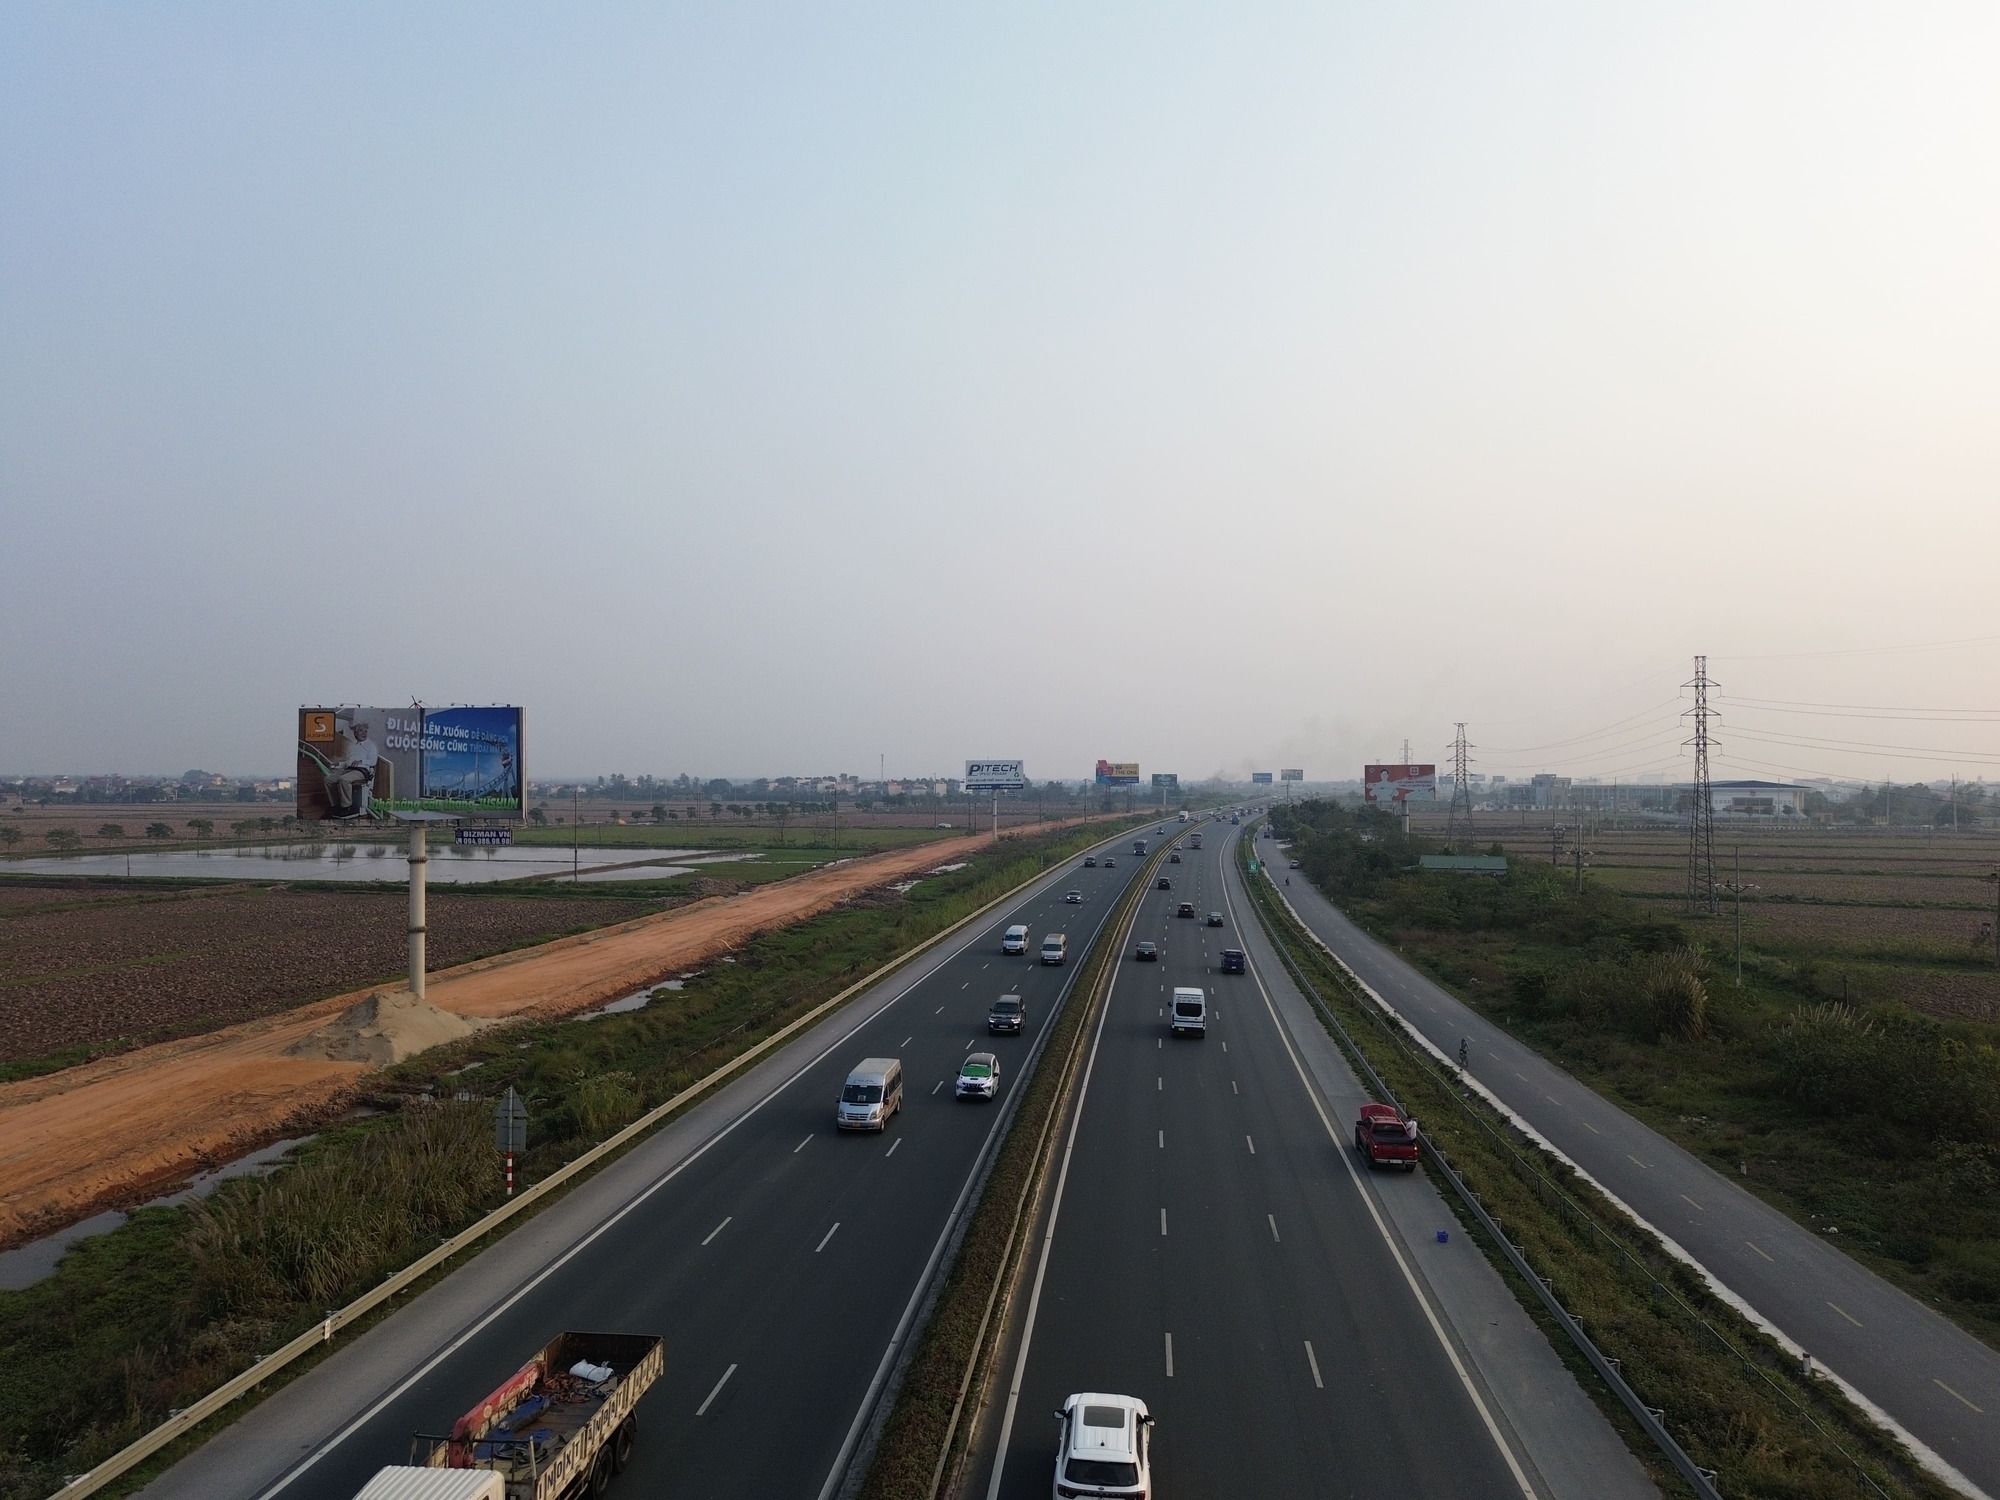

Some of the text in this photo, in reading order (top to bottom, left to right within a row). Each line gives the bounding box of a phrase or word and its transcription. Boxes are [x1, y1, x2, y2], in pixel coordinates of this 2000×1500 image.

[386, 717, 400, 730] ĐI
[403, 720, 420, 736] LẠI
[423, 721, 441, 736] LÊN
[442, 725, 469, 739] XUỐNG
[386, 734, 417, 752] CUỘC
[420, 736, 445, 751] SỐNG
[447, 739, 468, 752] CŨNG
[968, 764, 1018, 776] PITECH
